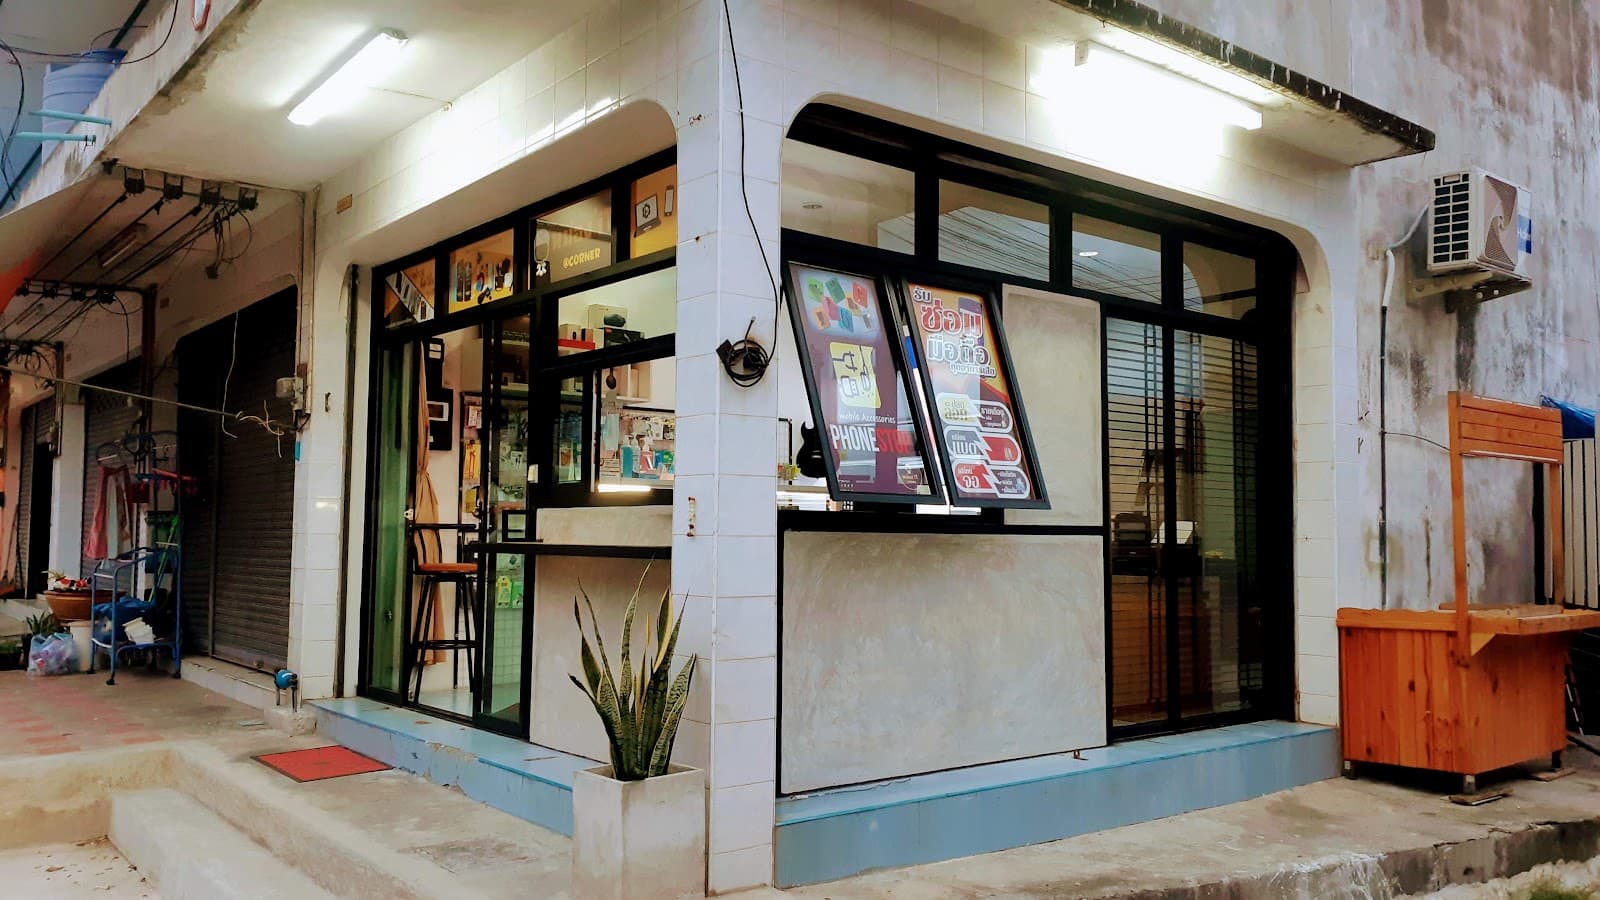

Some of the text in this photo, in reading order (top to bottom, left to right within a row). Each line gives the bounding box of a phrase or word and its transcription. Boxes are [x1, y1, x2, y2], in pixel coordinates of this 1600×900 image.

[914, 287, 931, 302] รับ
[921, 298, 983, 338] ซ่อม
[927, 334, 991, 365] มือถือ
[962, 475, 979, 488] จอ
